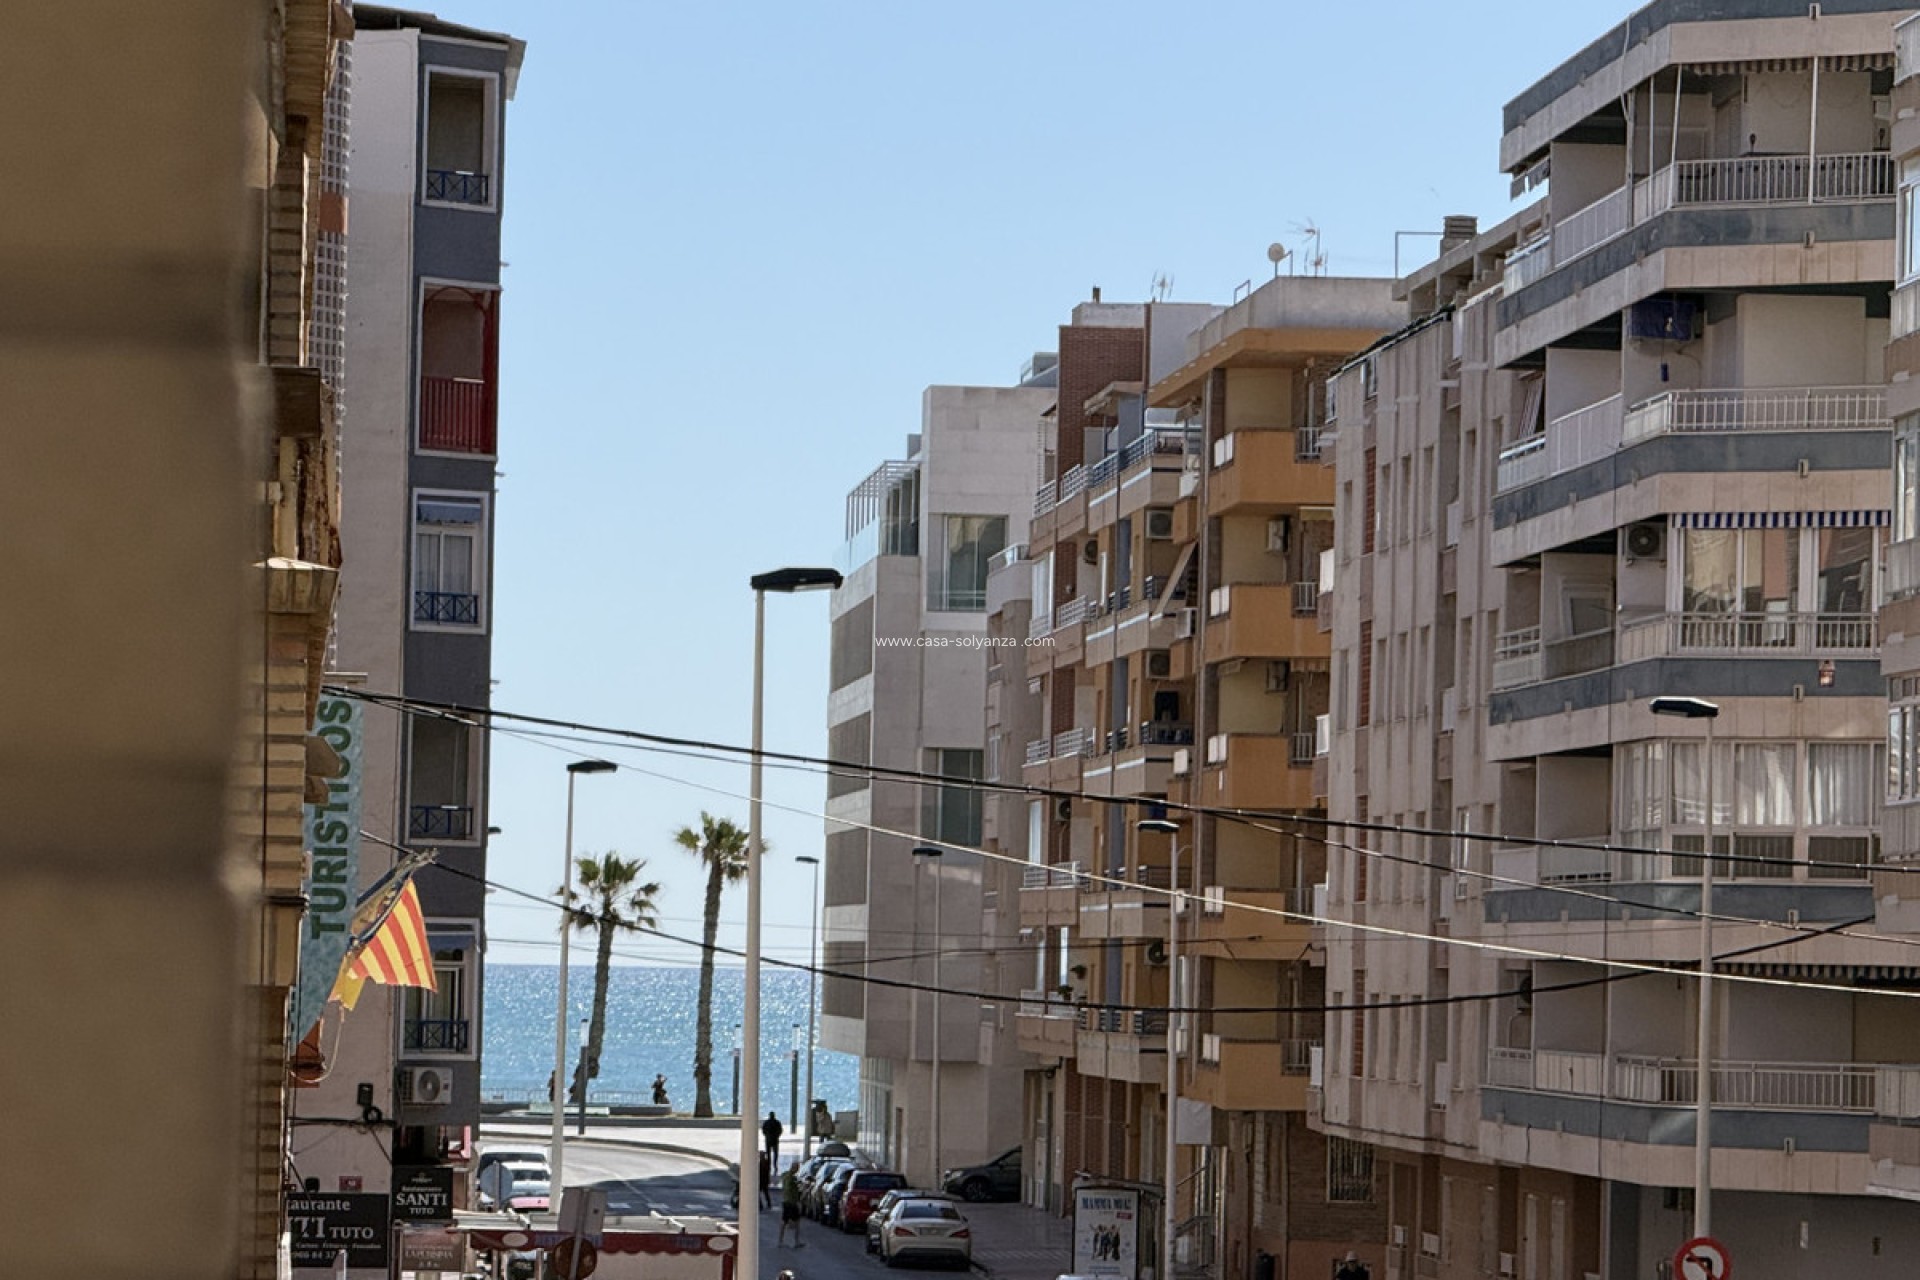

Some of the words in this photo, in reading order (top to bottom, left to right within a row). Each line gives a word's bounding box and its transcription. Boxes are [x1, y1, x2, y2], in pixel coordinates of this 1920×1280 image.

[396, 1192, 448, 1206] SANTI
[409, 1207, 434, 1215] TUTO
[329, 1226, 374, 1240] TUTO
